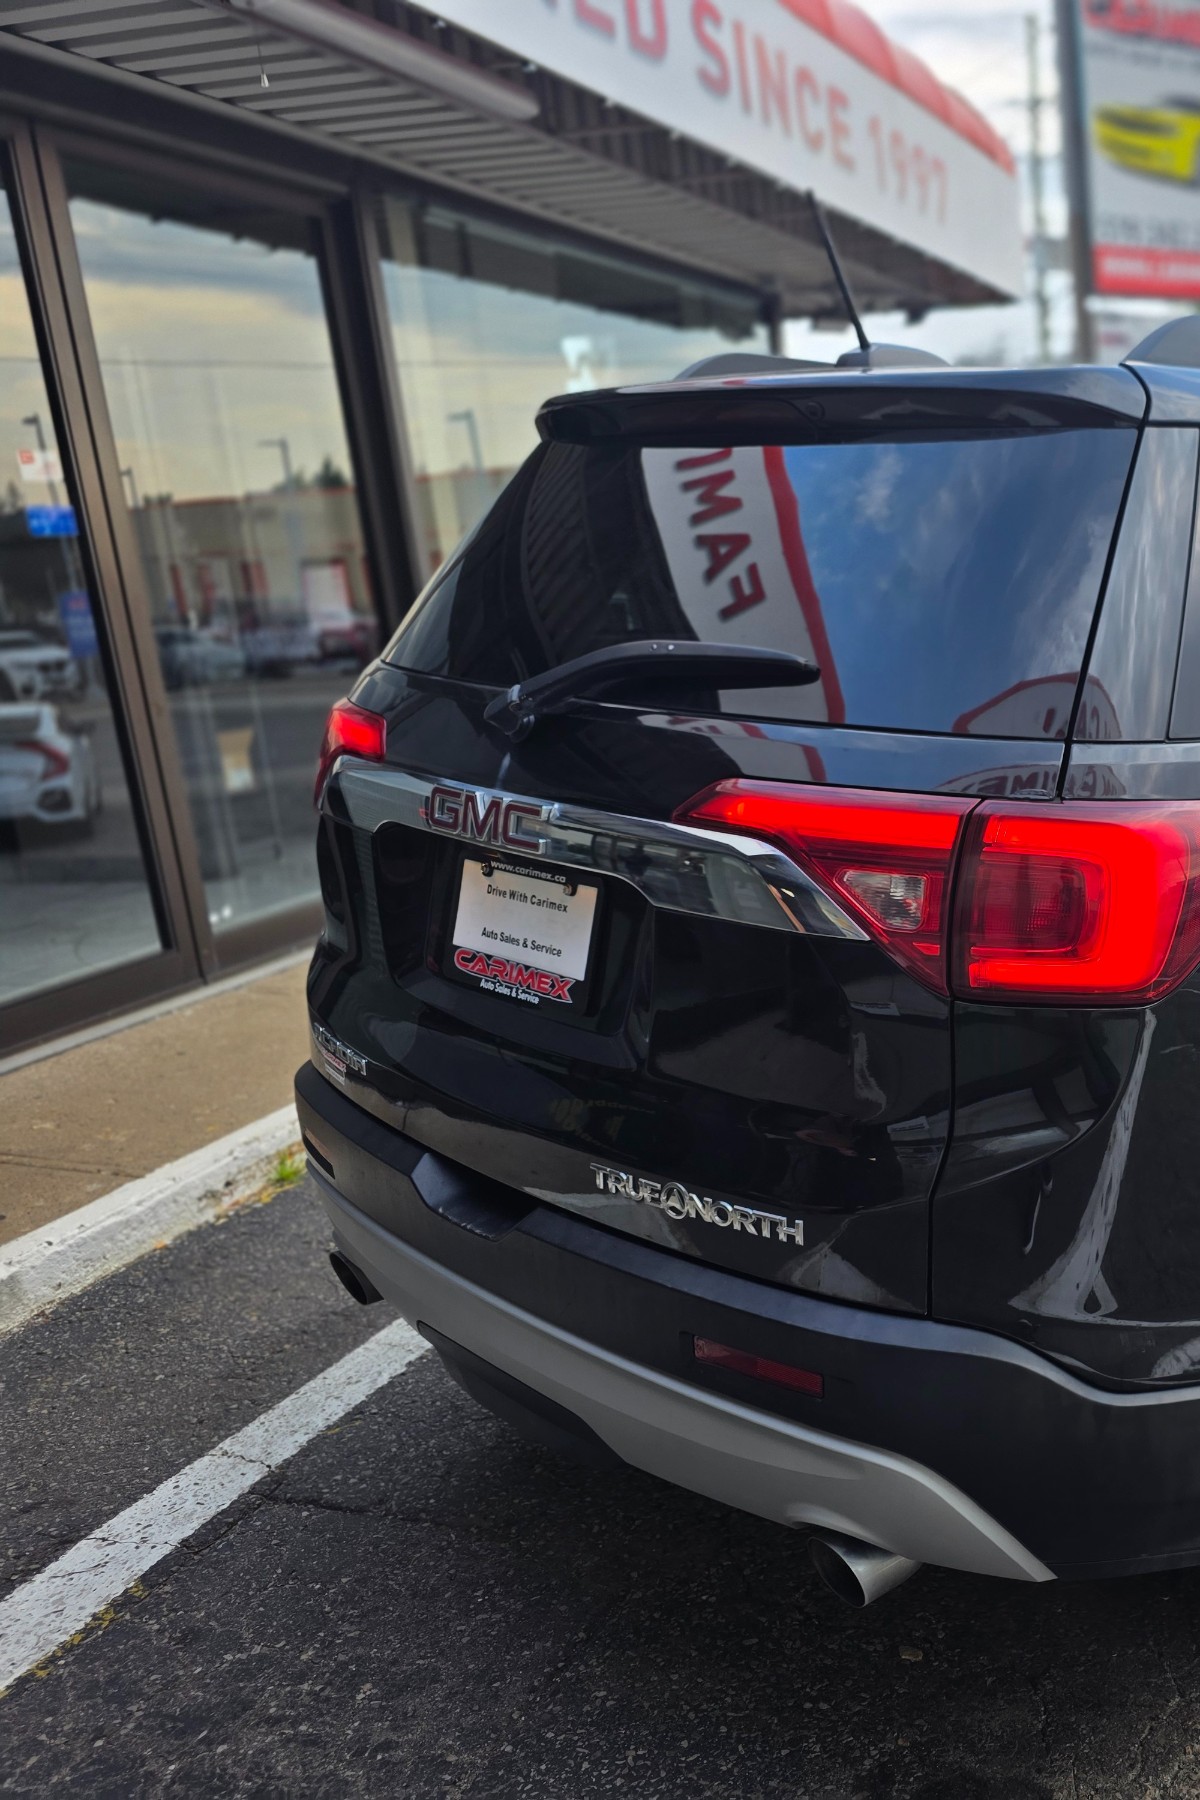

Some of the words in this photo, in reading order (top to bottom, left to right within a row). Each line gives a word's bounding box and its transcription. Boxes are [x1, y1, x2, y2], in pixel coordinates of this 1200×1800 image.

[692, 0, 855, 172] SINCE
[868, 115, 948, 226] 1997
[430, 784, 550, 854] GMC
[490, 860, 567, 884] www.carimex.ca
[487, 884, 507, 899] Drive
[508, 889, 528, 903] With
[530, 894, 568, 913] Carimex
[481, 927, 498, 940] Auto
[499, 932, 520, 947] Sales
[522, 938, 528, 948] &
[531, 940, 562, 957] Service
[454, 948, 576, 1003] CARIMEX
[480, 978, 494, 991] Auto
[495, 982, 511, 996] Sales
[518, 989, 540, 1004] Service
[590, 1163, 663, 1209] TRUE
[688, 1192, 804, 1246] NORTH
